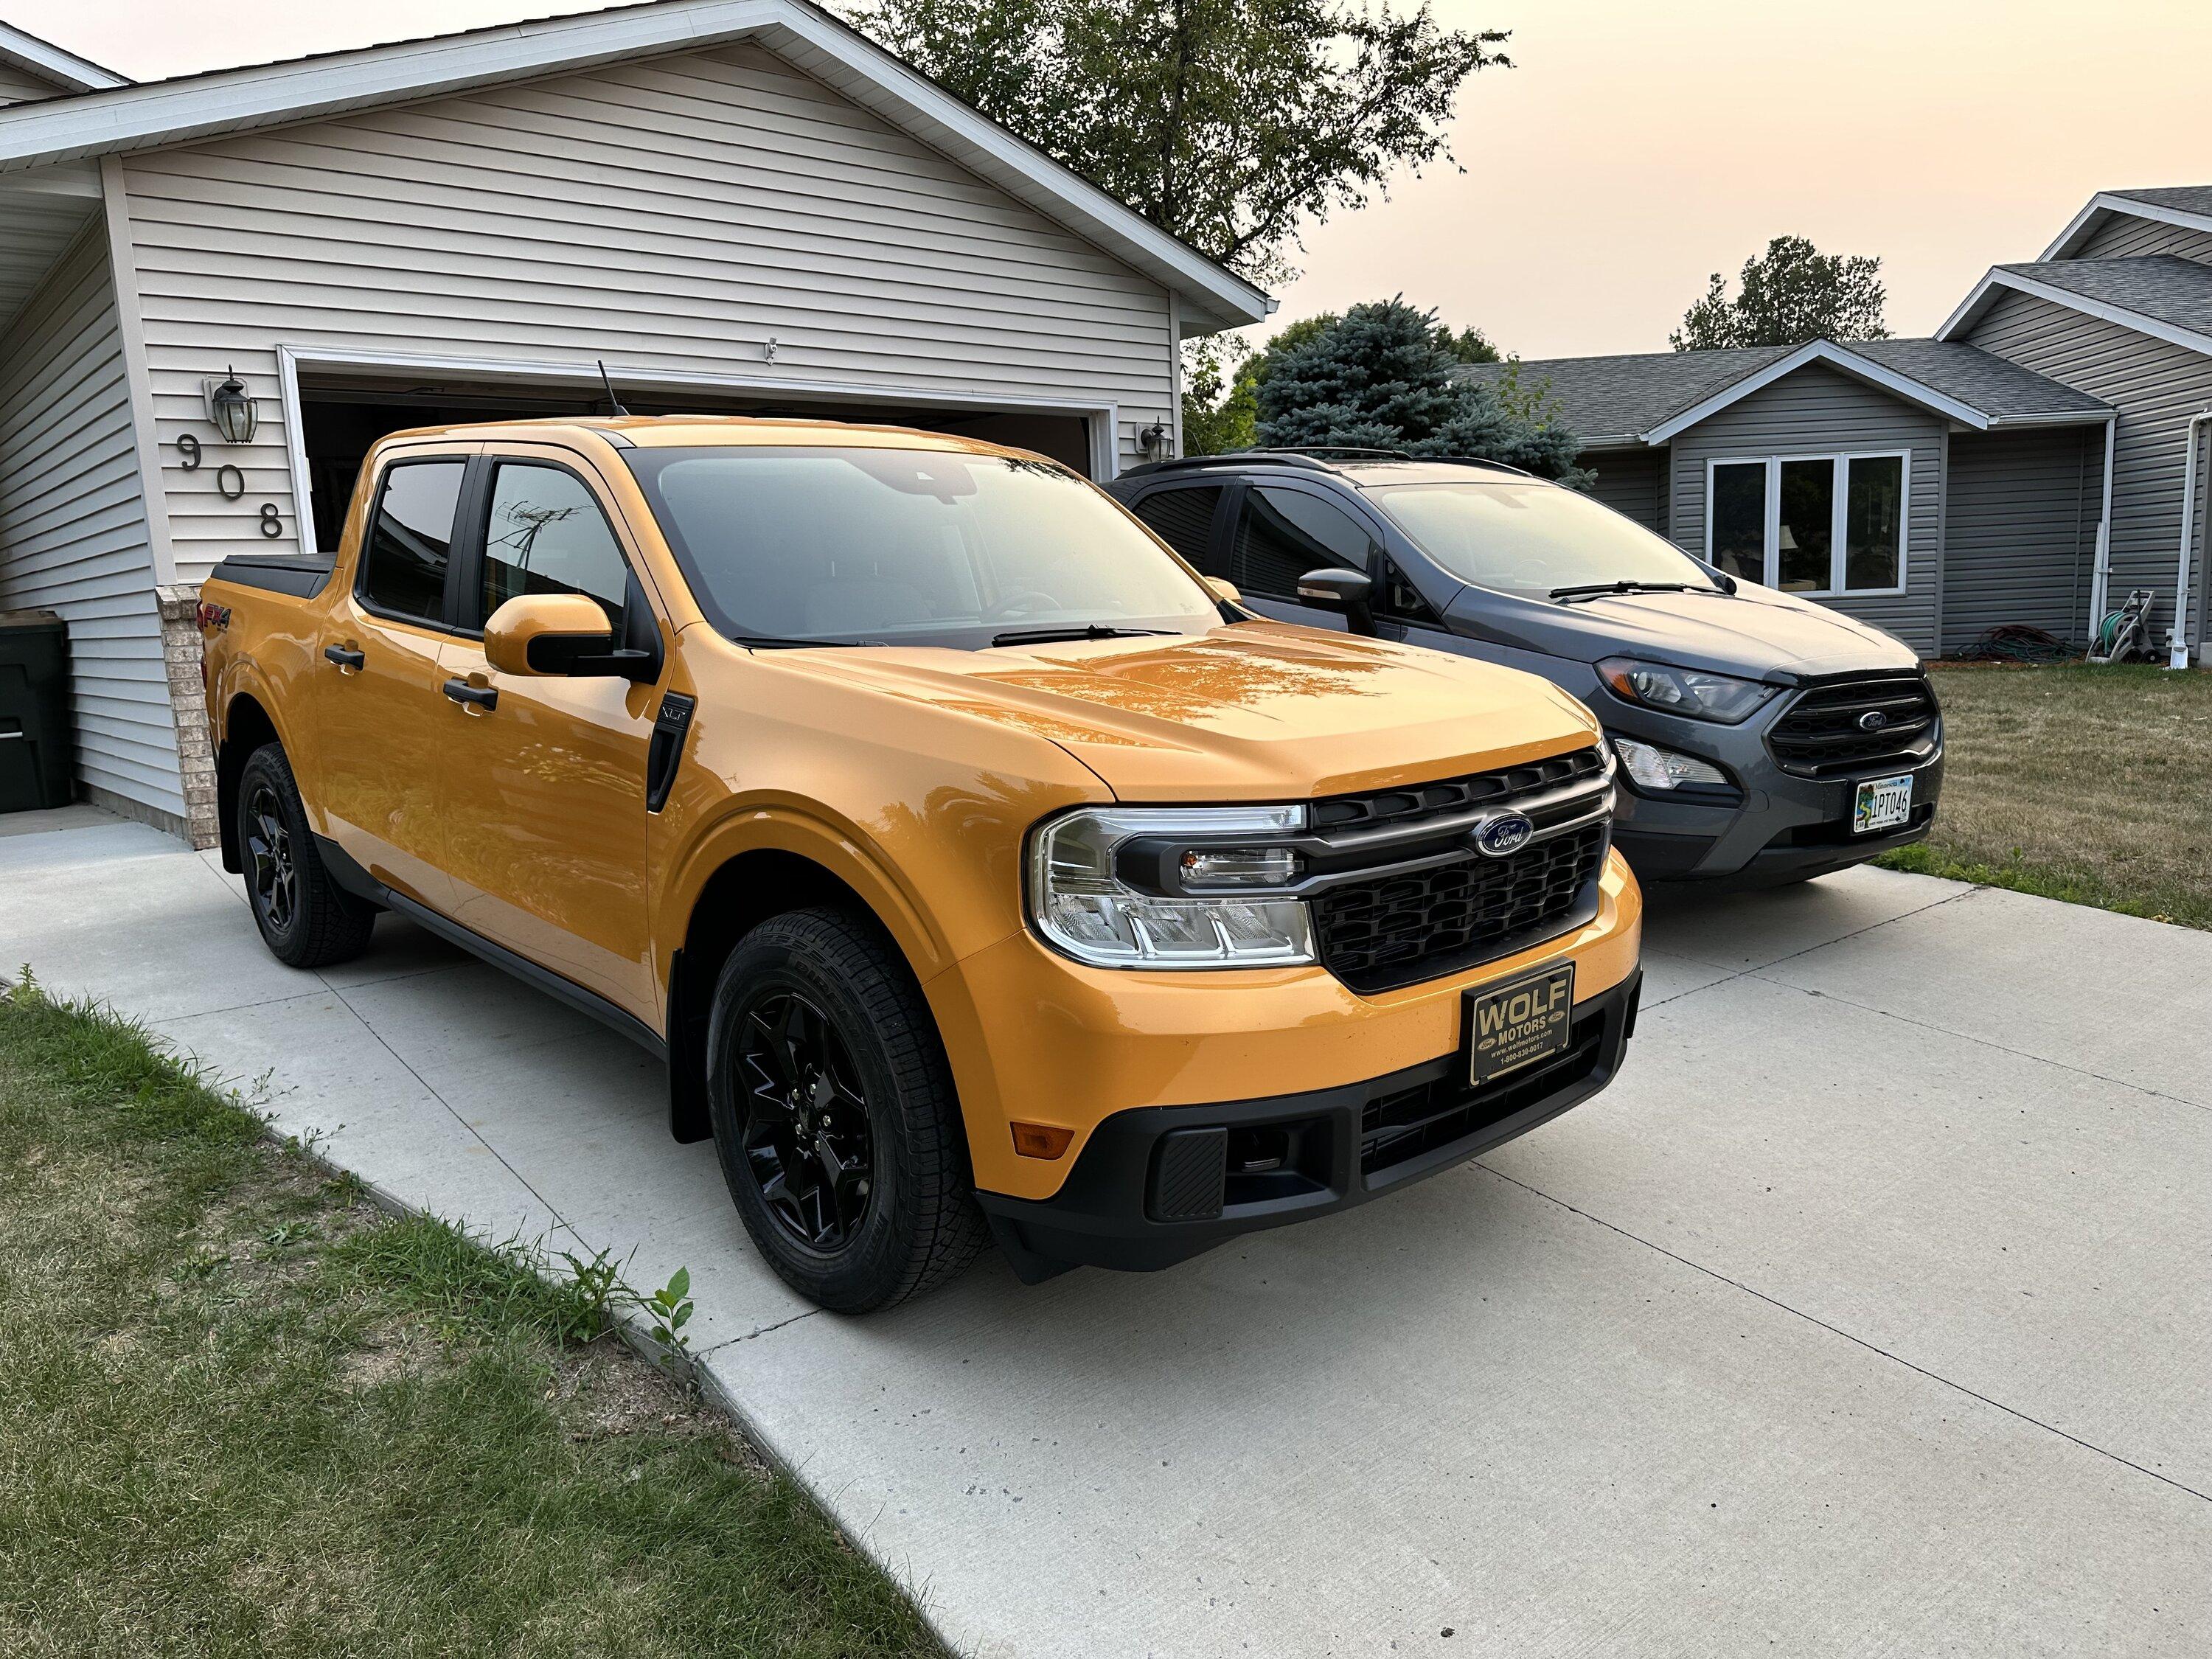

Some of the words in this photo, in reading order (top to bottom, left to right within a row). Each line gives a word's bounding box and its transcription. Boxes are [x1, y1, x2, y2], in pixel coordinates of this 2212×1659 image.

[177, 434, 282, 538] 908
[204, 603, 232, 628] FX4
[662, 706, 686, 721] XLT
[1875, 782, 1898, 790] Minnesota
[1871, 790, 1907, 818] 1PT046
[1493, 823, 1525, 848] Ford
[1479, 978, 1567, 1037] WOLF
[1491, 1029, 1553, 1058] www.wolfmotors.com
[1498, 1015, 1547, 1046] MOTORS
